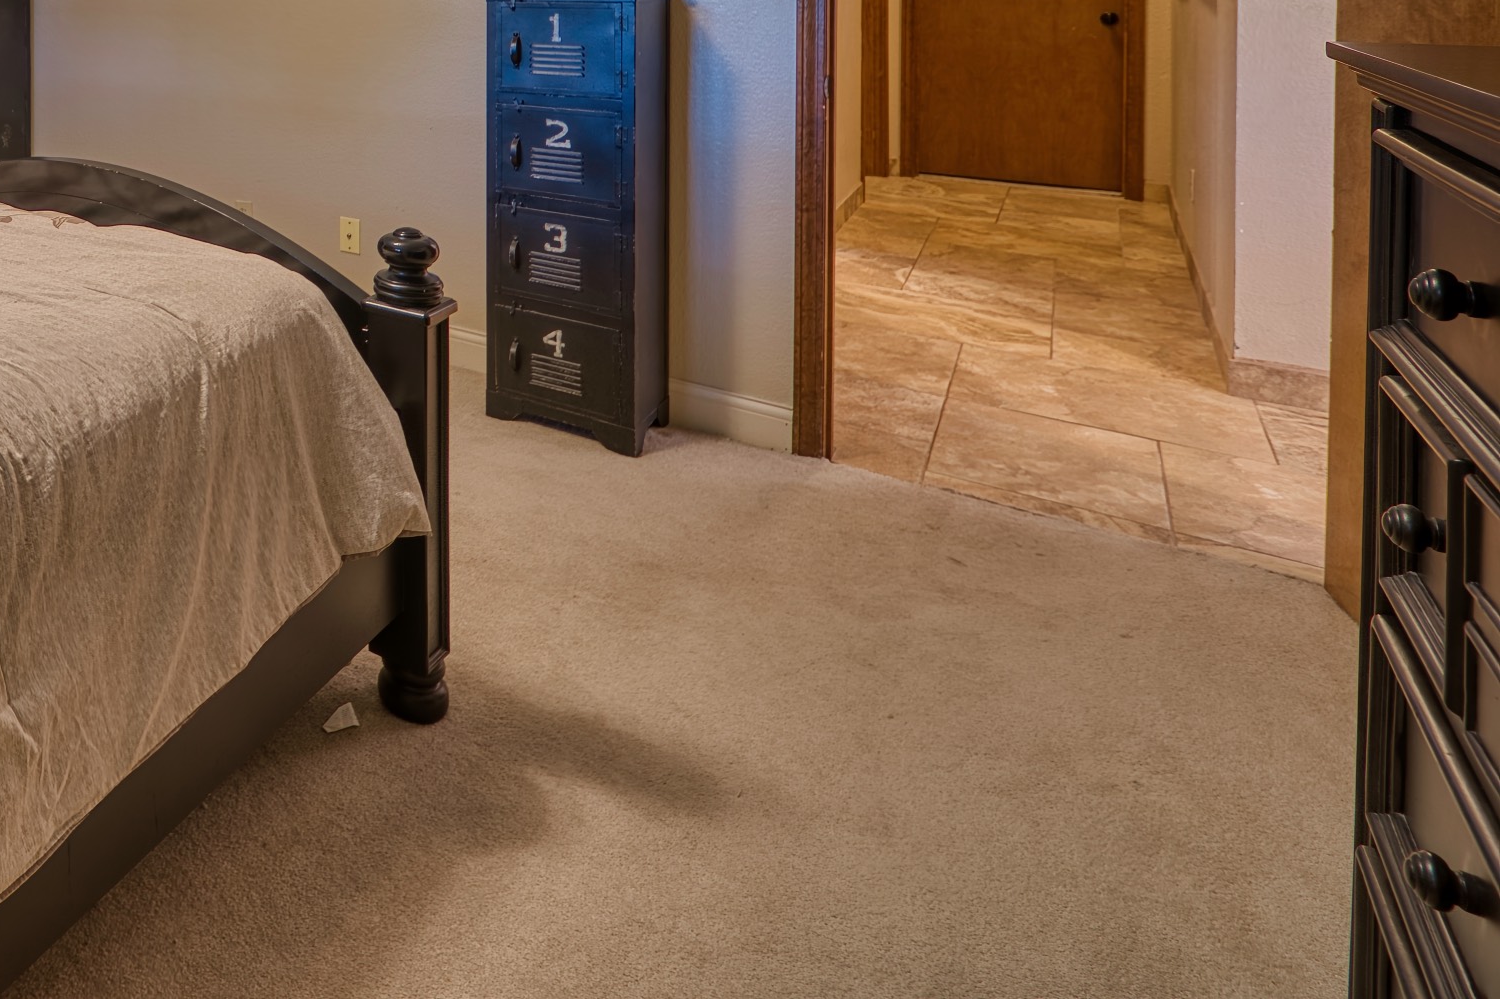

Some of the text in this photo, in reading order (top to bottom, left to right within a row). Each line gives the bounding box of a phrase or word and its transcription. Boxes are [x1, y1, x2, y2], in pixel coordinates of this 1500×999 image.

[548, 12, 562, 43] 1
[544, 118, 572, 149] 2
[544, 222, 568, 254] 3
[542, 328, 566, 358] 4
